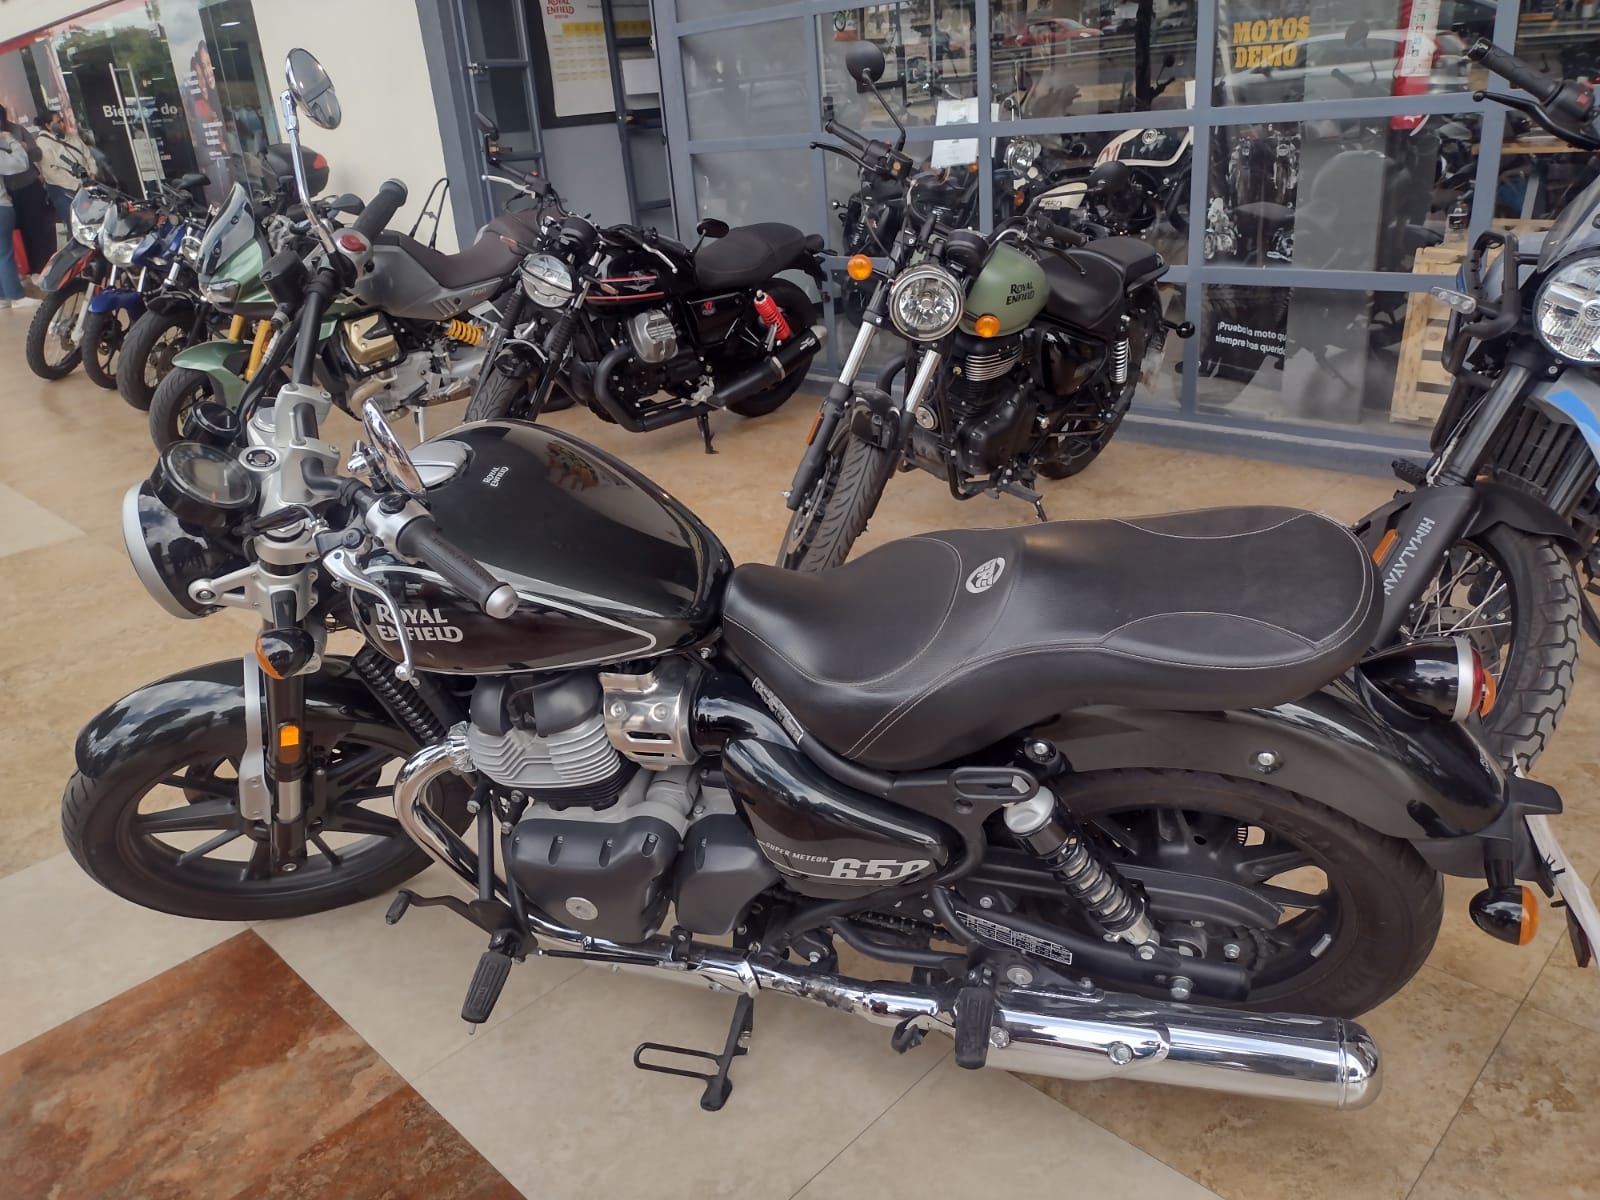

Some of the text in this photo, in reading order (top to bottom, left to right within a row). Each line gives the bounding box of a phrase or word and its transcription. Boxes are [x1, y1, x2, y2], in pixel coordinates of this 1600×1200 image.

[1233, 16, 1311, 44] MOTOS
[1235, 43, 1298, 69] DEMO
[1006, 290, 1035, 306] ENFIELD
[1010, 281, 1033, 294] ROYAL
[1215, 334, 1246, 347] siempre
[1254, 330, 1277, 339] moto
[1383, 516, 1436, 597] HIMALAYAN
[765, 842, 931, 881] SUPER METEOR 650
